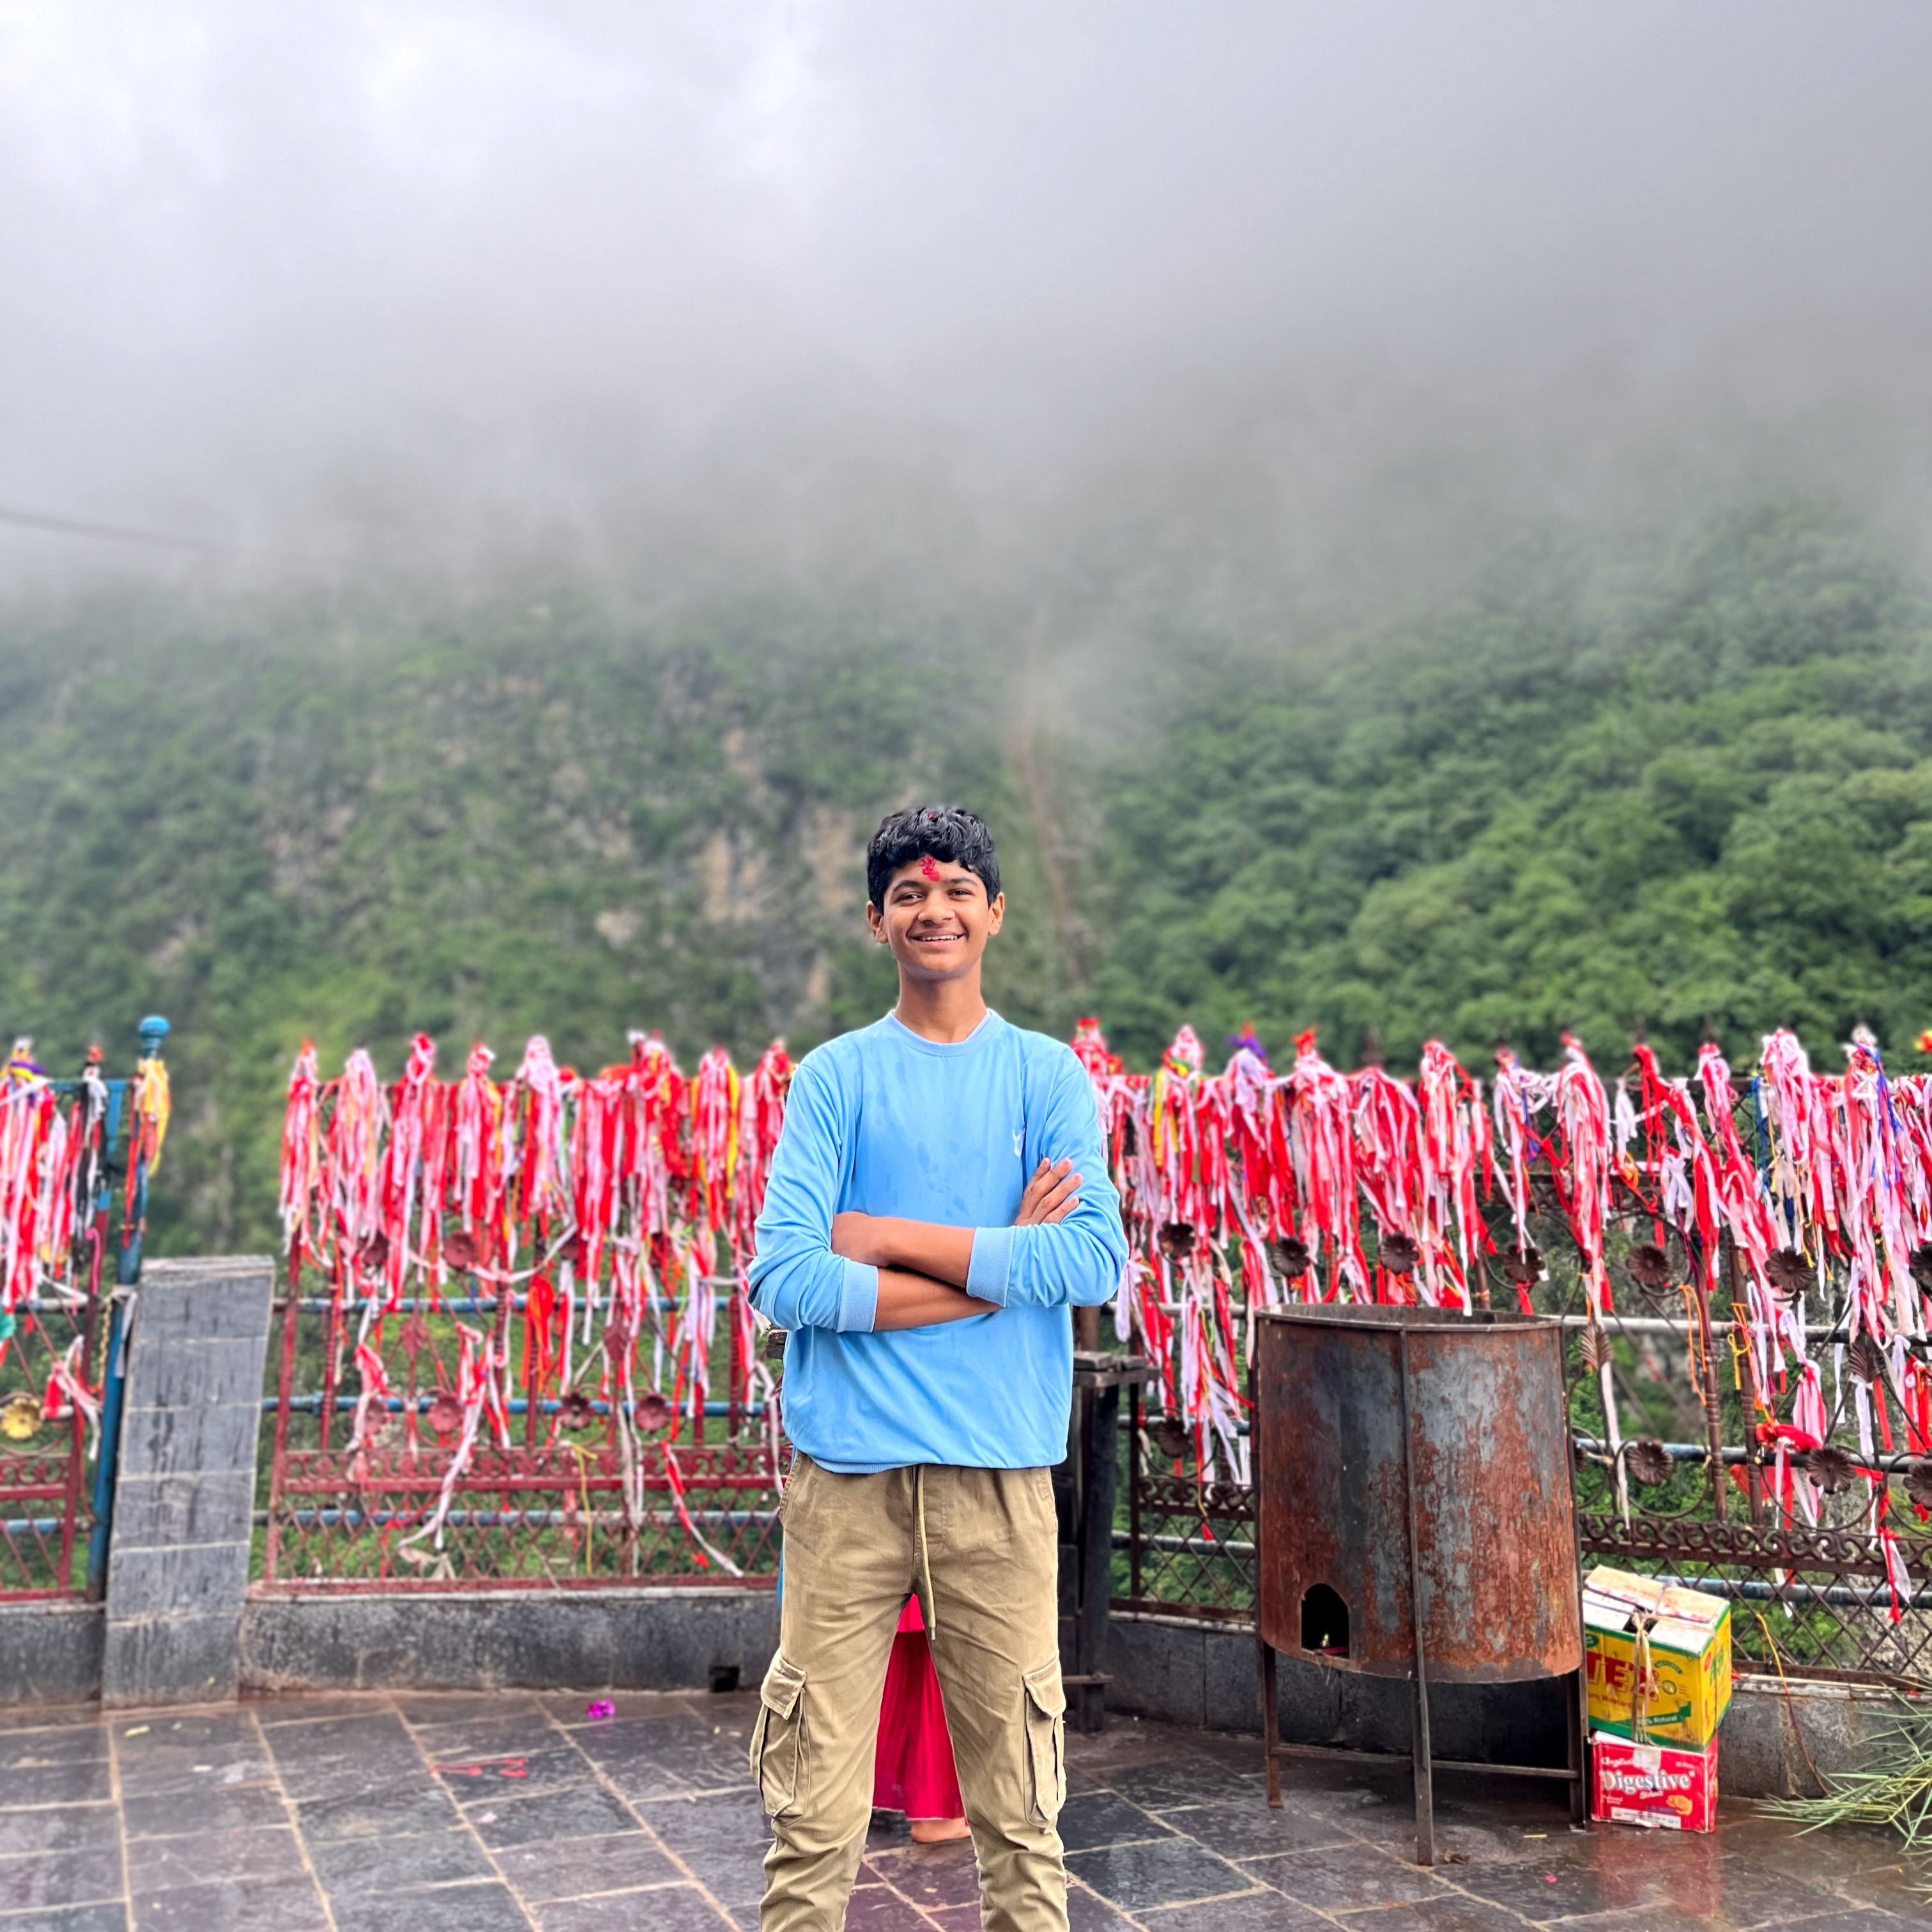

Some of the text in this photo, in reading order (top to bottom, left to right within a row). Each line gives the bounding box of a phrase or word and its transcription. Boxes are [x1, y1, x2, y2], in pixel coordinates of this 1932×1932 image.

[1588, 1692, 1599, 1700] ure
[1601, 1694, 1632, 1708] Mustard
[1653, 1715, 1677, 1724] Natural
[1602, 1770, 1690, 1794] Digestive
